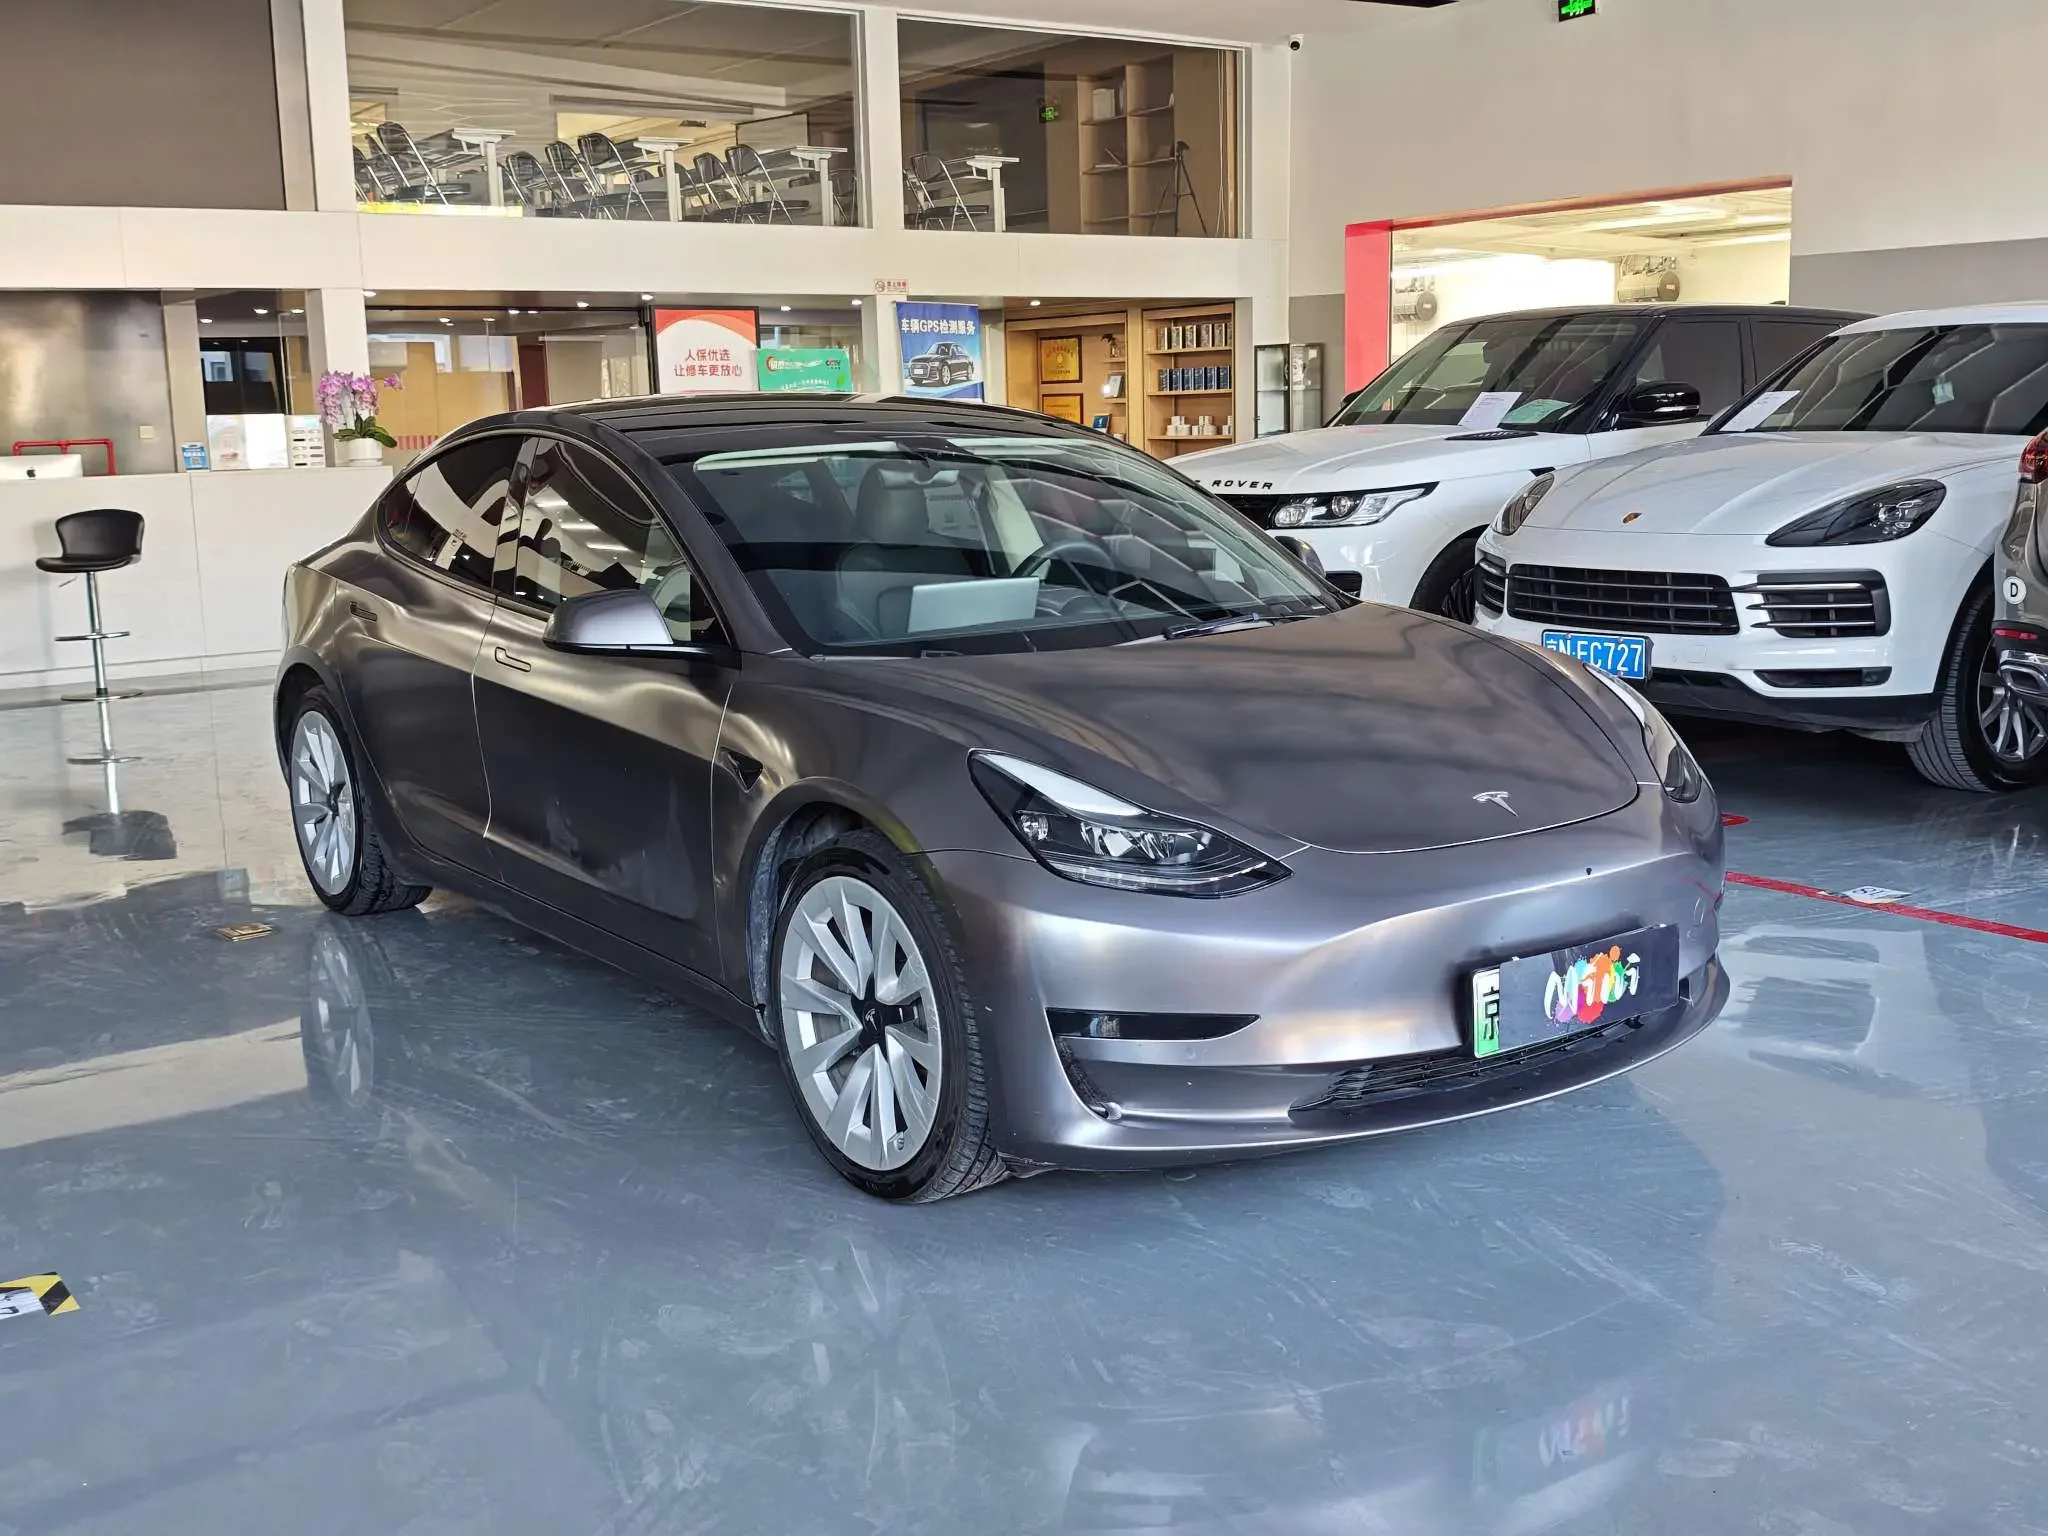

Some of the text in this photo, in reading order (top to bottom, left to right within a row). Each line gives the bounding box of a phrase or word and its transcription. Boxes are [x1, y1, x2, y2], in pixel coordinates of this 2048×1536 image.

[901, 318, 976, 335] 车辆GPS检测服务
[685, 348, 731, 361] 人保优选
[674, 364, 742, 377] 让修车更放心
[1211, 479, 1273, 490] ROVER
[2010, 582, 2018, 597] D
